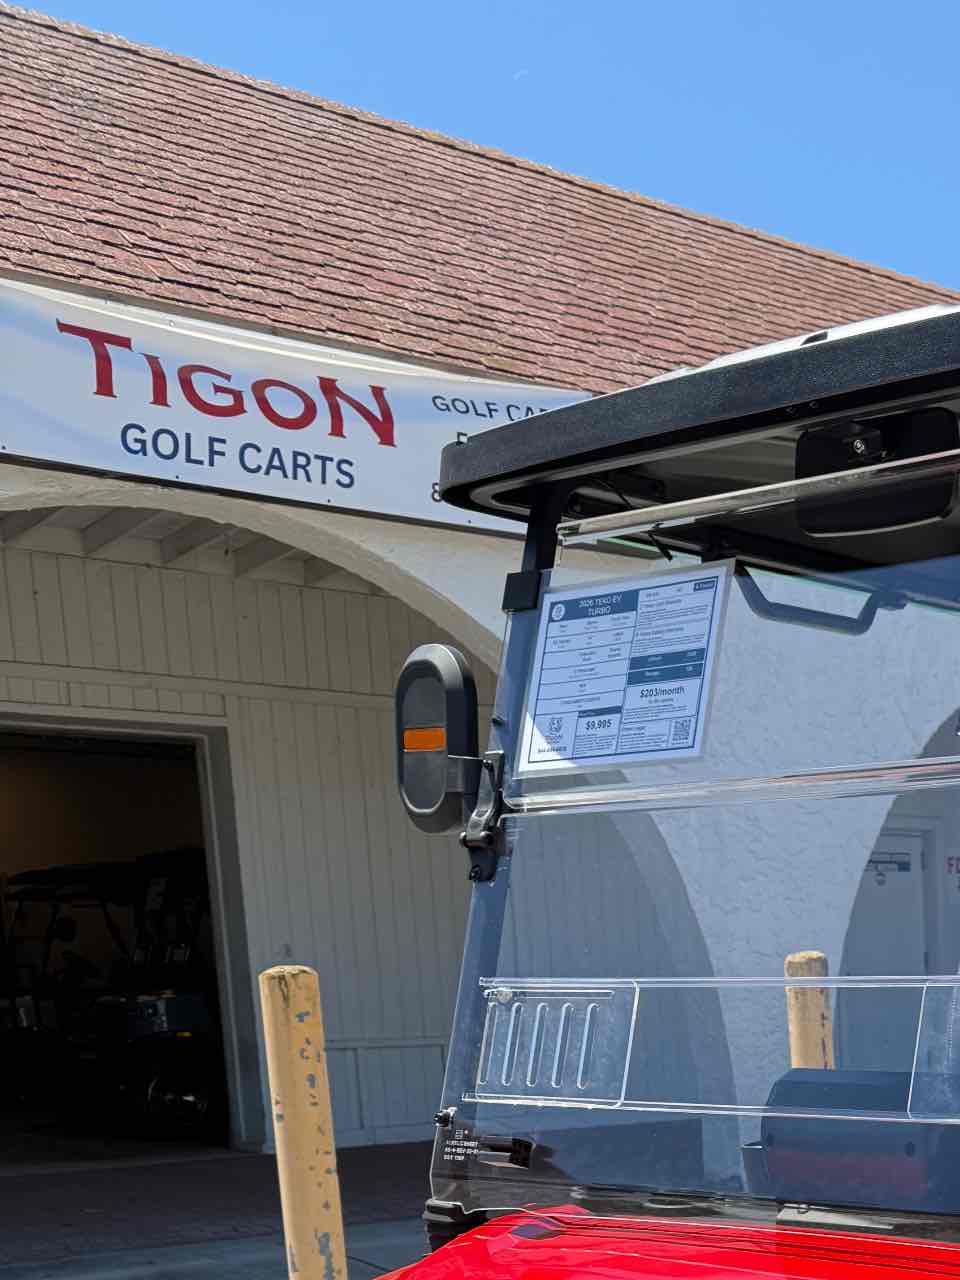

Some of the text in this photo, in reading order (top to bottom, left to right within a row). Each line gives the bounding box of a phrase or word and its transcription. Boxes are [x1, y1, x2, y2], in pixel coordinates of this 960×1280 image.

[55, 318, 397, 448] TIGON
[432, 395, 549, 422] GOLF CA
[120, 422, 356, 489] GOLF CARTS
